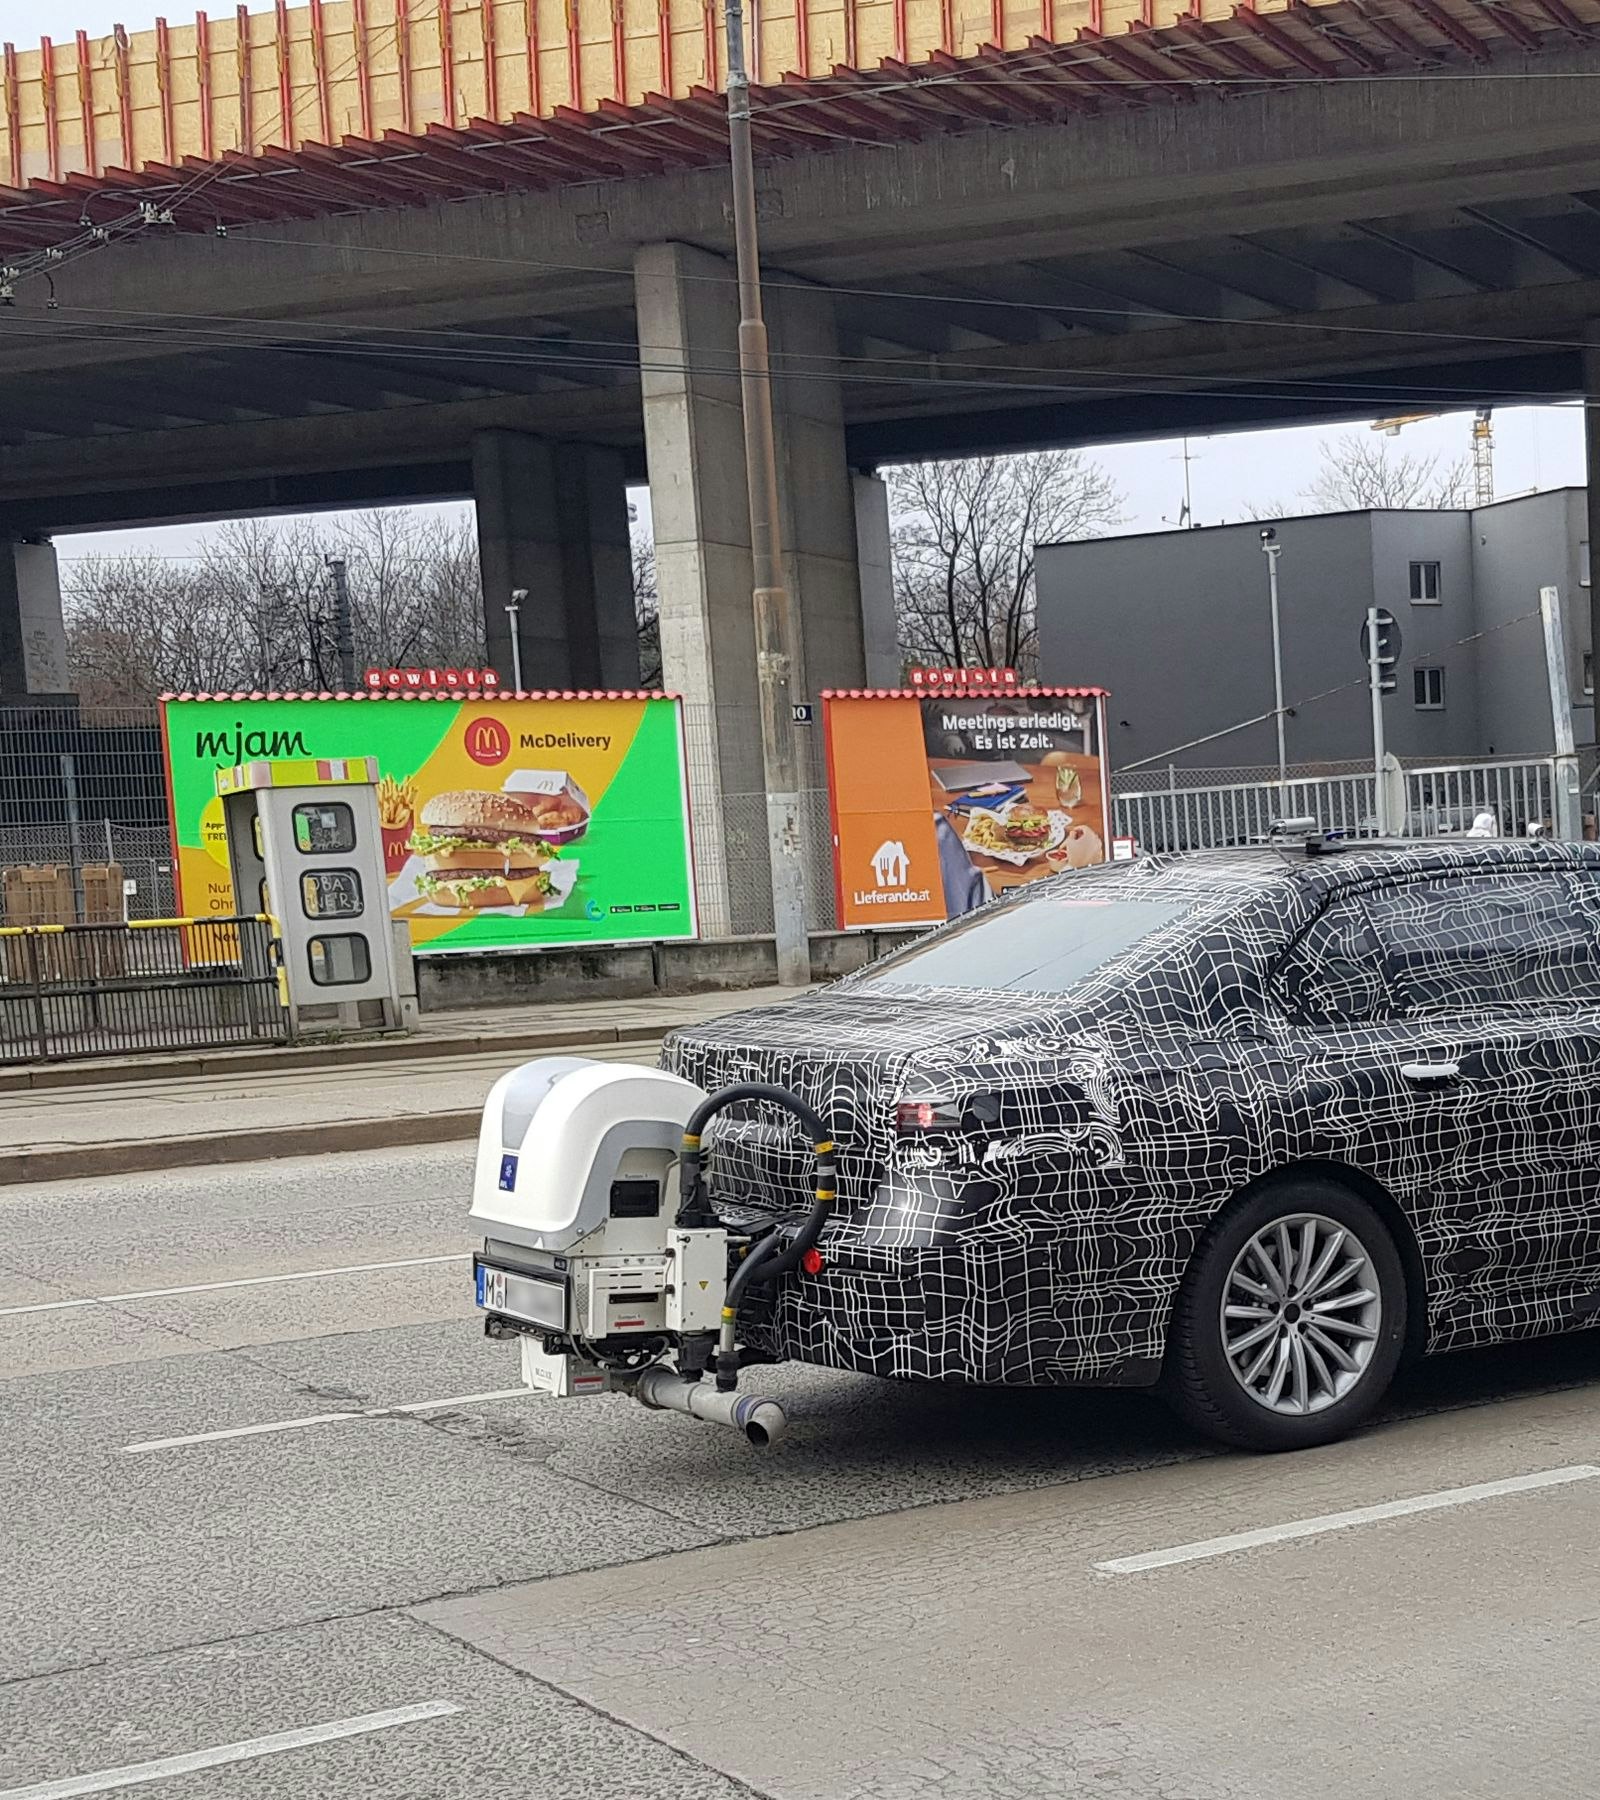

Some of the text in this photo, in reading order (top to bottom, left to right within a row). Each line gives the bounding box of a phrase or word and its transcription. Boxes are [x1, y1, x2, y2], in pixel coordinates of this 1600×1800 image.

[366, 670, 498, 688] gewista
[912, 669, 1016, 684] gewista
[942, 713, 1083, 733] Meetings erledigt.
[195, 721, 312, 769] mjam
[519, 733, 612, 751] McDelivery
[975, 733, 1054, 750] Es ist Zeit.
[208, 883, 231, 894] Nur
[854, 887, 931, 905] Lieferando.at
[485, 1272, 495, 1305] M
